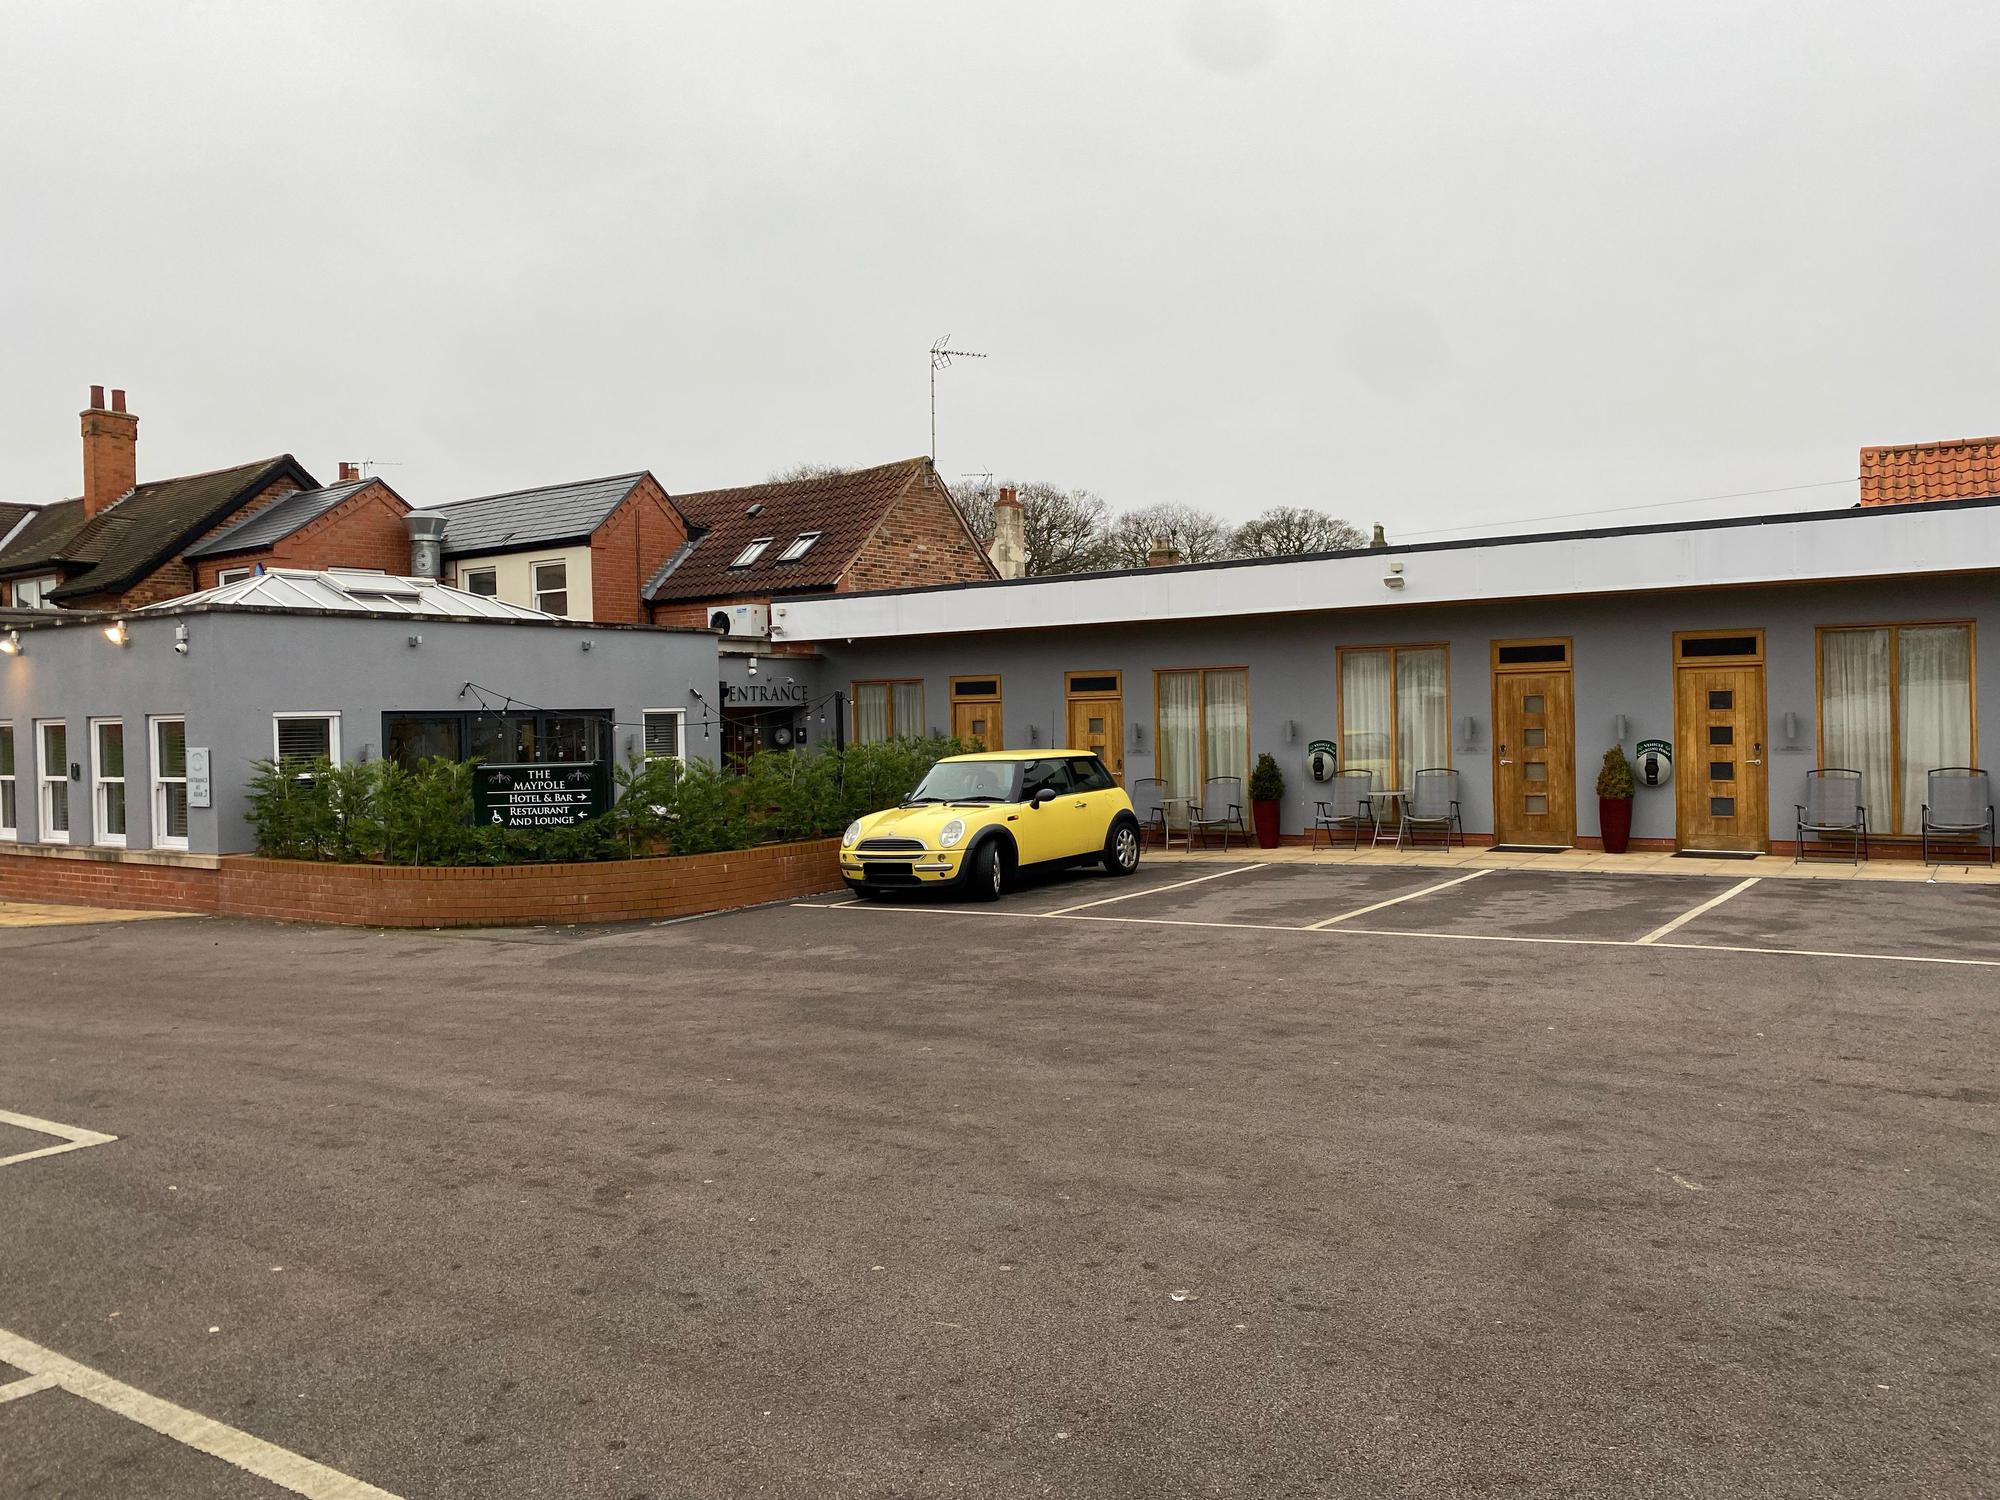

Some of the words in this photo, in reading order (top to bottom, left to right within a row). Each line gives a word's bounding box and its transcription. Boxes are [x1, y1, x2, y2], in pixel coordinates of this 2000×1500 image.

[729, 685, 808, 702] ENTRANCE
[528, 769, 551, 779] THE
[513, 780, 565, 790] MAYPOLE
[509, 794, 542, 803] HOTEL
[543, 793, 553, 802] &
[554, 793, 574, 802] BAR
[510, 806, 570, 816] RESTAURANT
[509, 817, 532, 826] AND
[535, 816, 575, 825] LOUNGE
